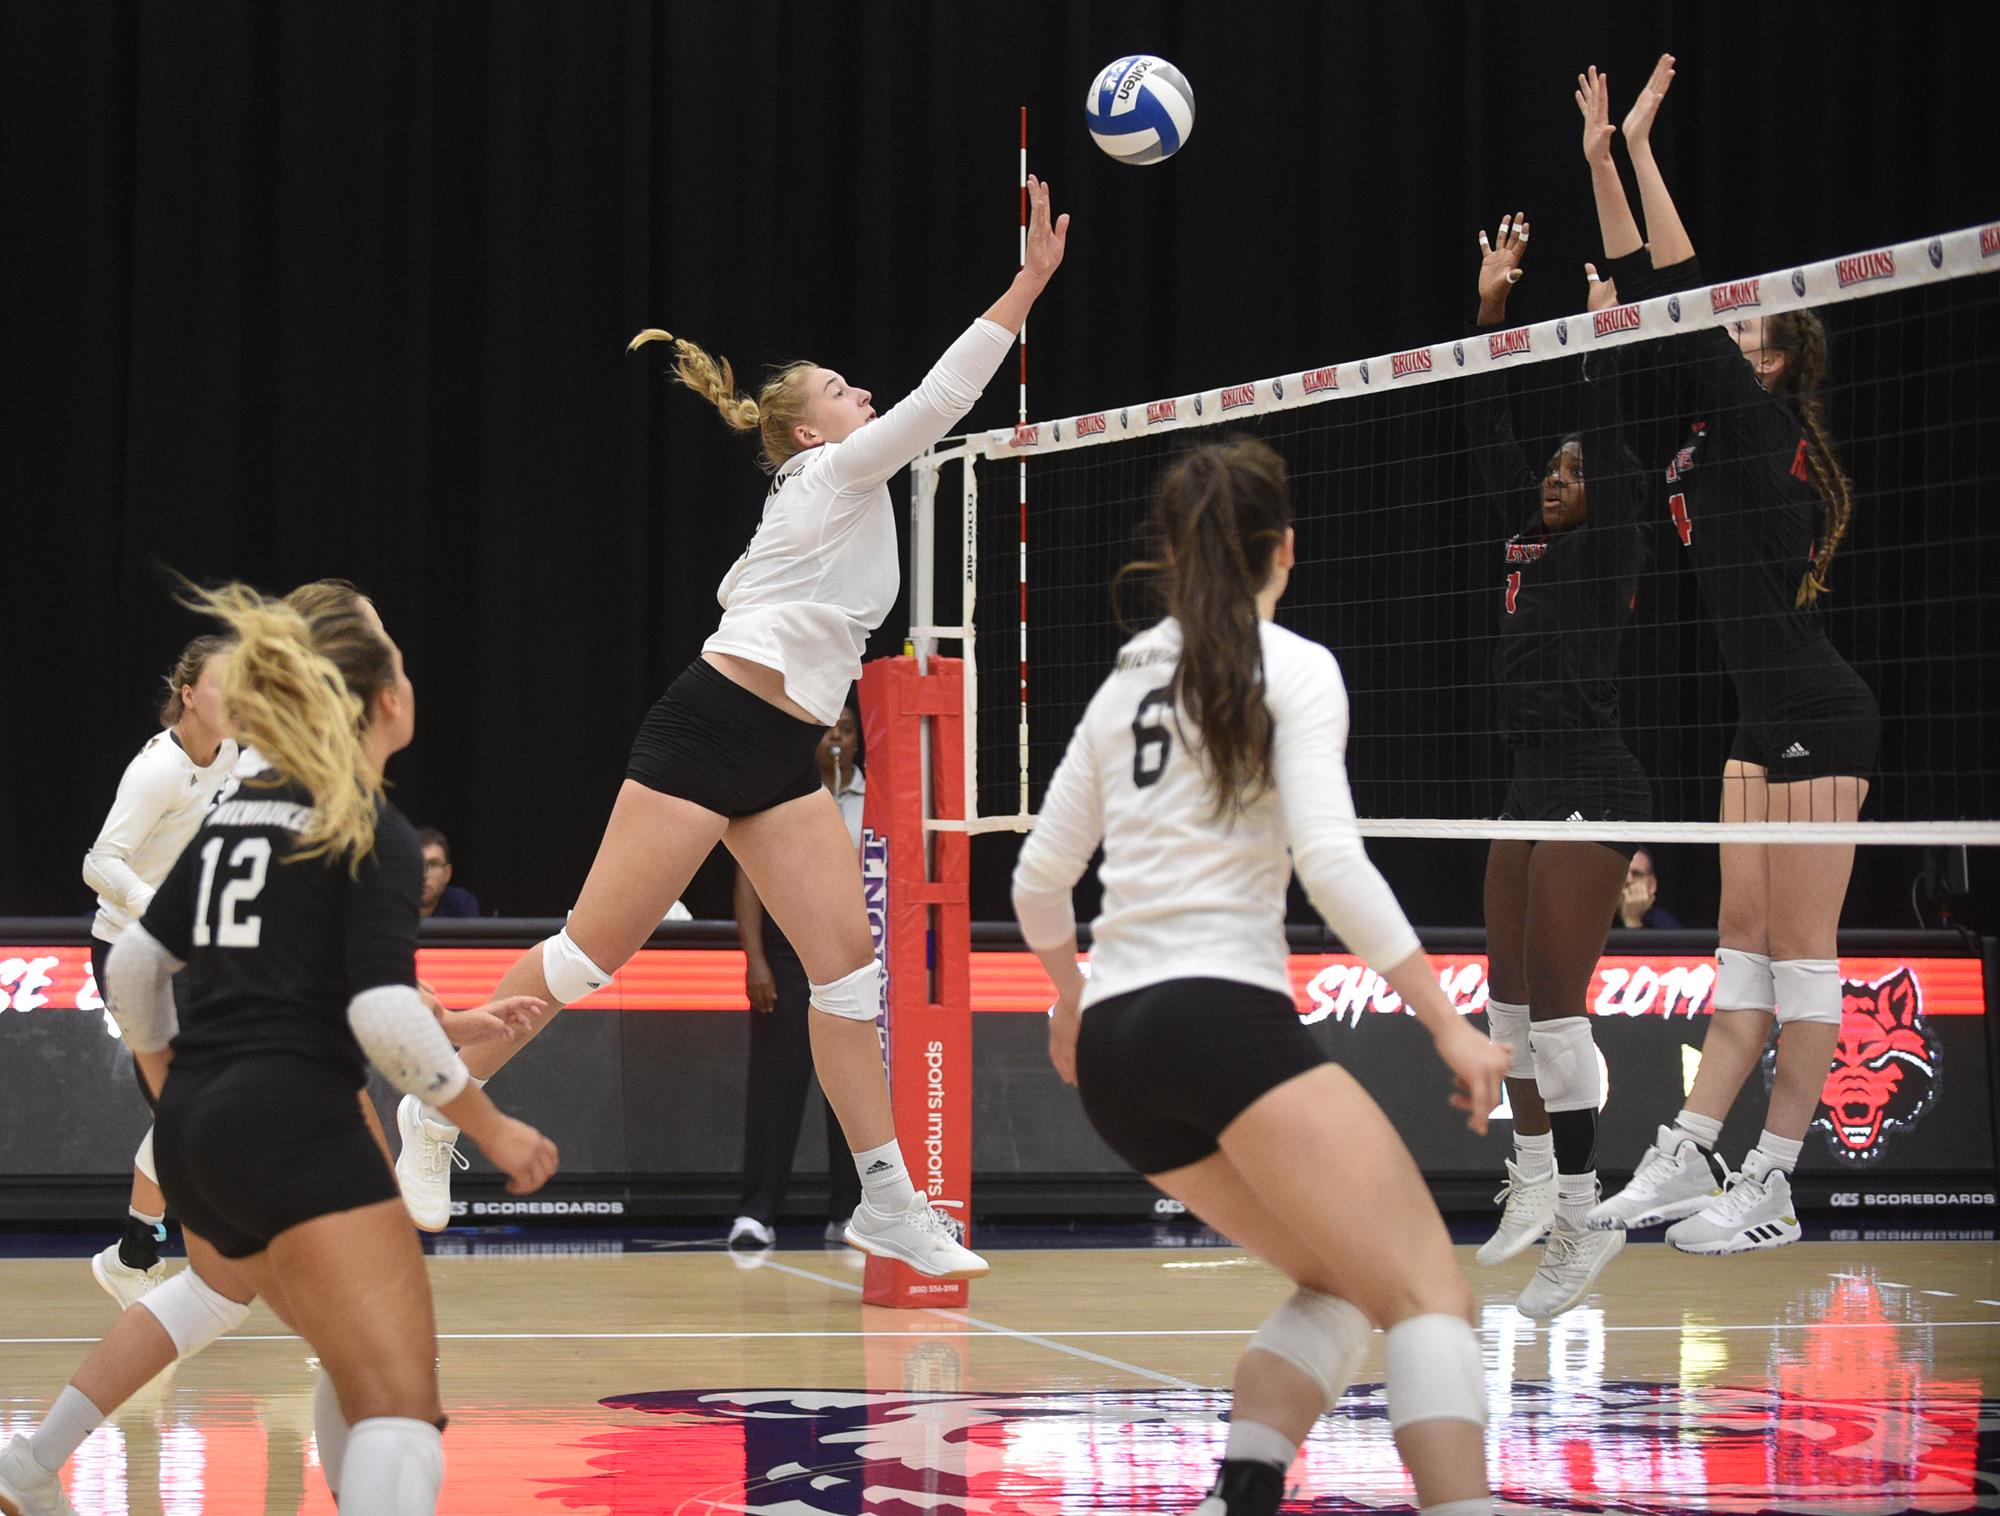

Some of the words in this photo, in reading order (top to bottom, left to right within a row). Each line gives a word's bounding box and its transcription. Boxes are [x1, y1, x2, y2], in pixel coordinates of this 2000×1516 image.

[1076, 413, 1106, 438] BRUINS
[1221, 384, 1255, 411] BRUINS
[1302, 367, 1339, 395] BELMONT
[1392, 348, 1432, 378] BRUINS
[1489, 328, 1530, 359] BELMONT
[1594, 305, 1640, 338] BRUINS
[1710, 279, 1761, 314] BELMONT
[1836, 250, 1895, 288] BRUINS
[1132, 686, 1176, 789] 6
[193, 837, 272, 948] 12
[1594, 963, 1716, 1020] 2019
[924, 1040, 945, 1109] sports
[924, 1112, 945, 1196] imports
[450, 1201, 469, 1216] ES
[473, 1202, 624, 1215] SCOREBOARDS
[1864, 1193, 1995, 1205] SCOREBOARDS
